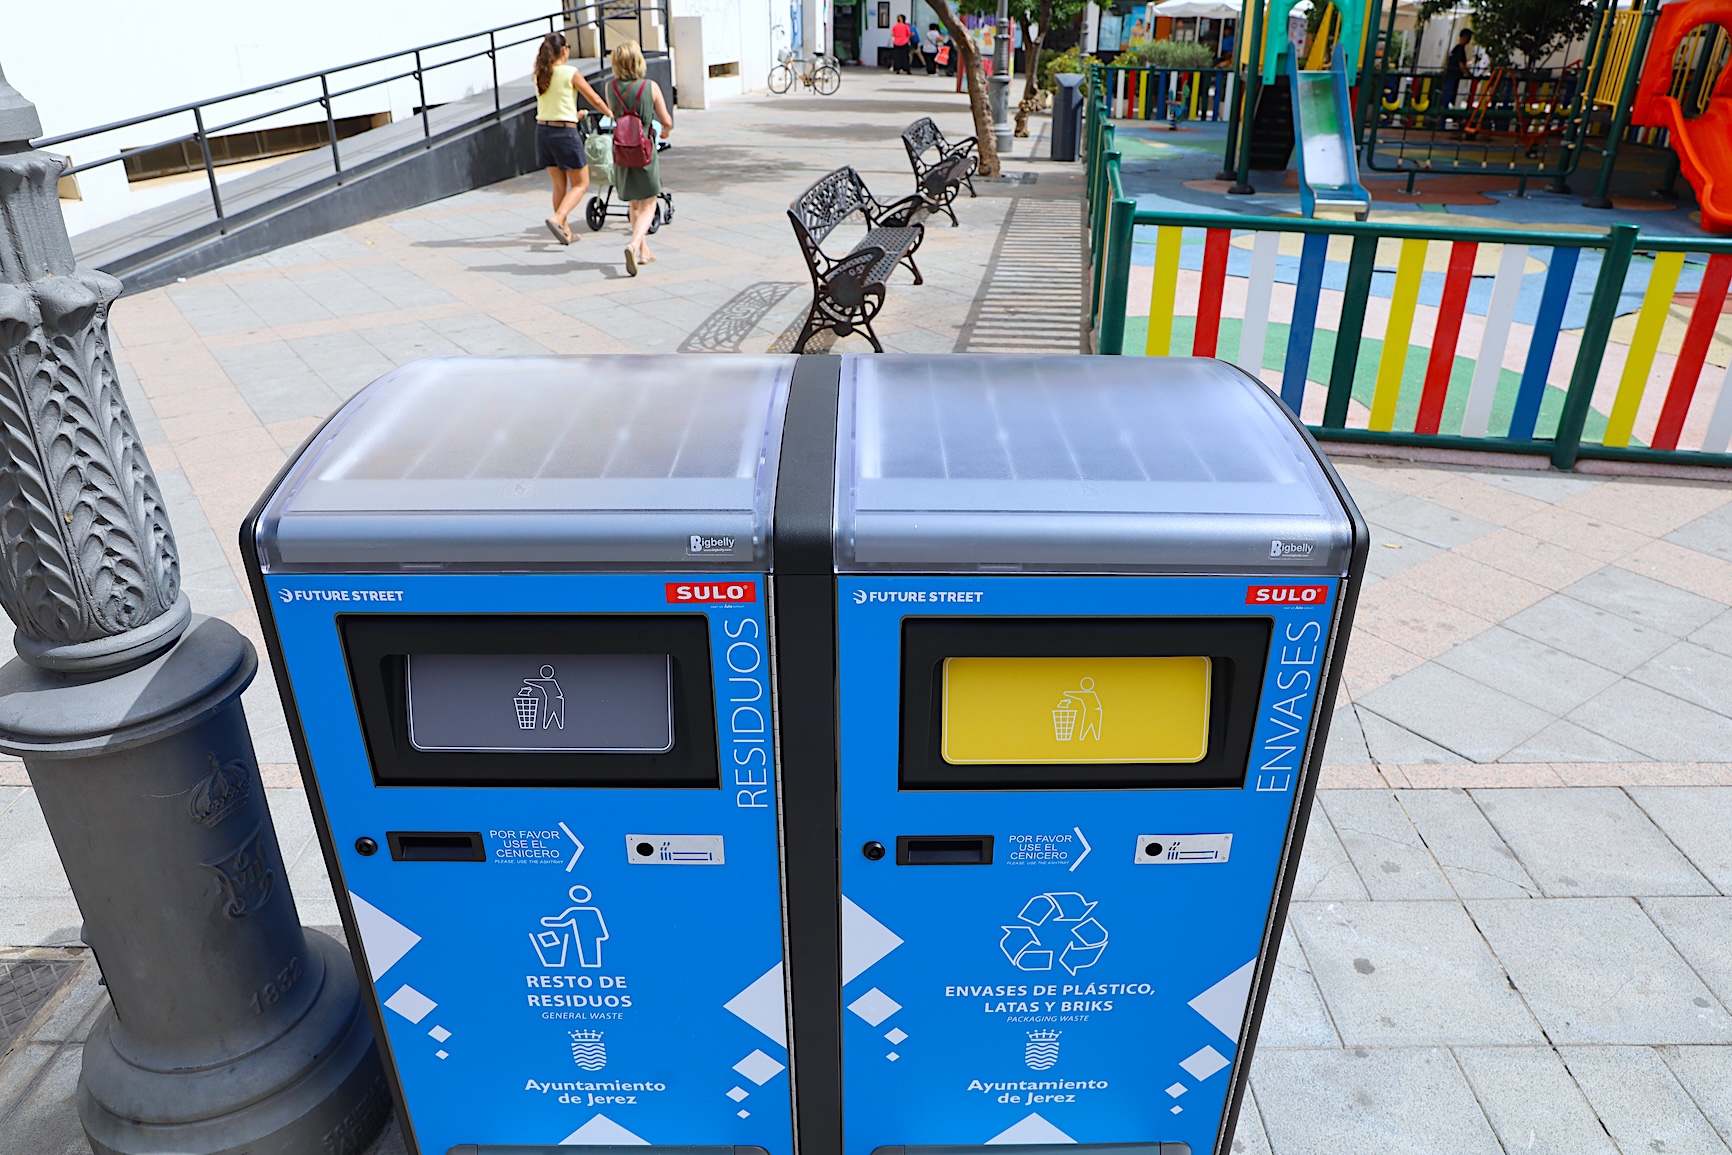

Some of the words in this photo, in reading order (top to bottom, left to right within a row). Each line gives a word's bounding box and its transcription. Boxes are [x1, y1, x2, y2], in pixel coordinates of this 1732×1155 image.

[690, 535, 735, 552] Bigbelly
[1270, 540, 1314, 557] Bigbelly
[294, 590, 350, 601] FUTURE
[352, 591, 403, 601] STREET
[870, 592, 926, 602] FUTURE
[929, 592, 983, 602] STREET
[1256, 621, 1321, 792] ENVASES
[724, 617, 769, 808] RESIDUOS
[489, 830, 516, 839] POR
[519, 830, 560, 839] FAVOR
[1009, 835, 1033, 843] POR
[1035, 834, 1072, 843] FAVOR
[503, 840, 528, 848] USE
[531, 840, 547, 848] EL
[1019, 843, 1041, 851] USE
[1044, 843, 1058, 851] EL
[496, 849, 560, 858] CENICERO
[1010, 851, 1068, 860] CENICERO
[526, 976, 592, 988] RESTO
[599, 976, 626, 988] DE
[946, 986, 1027, 996] ENVASES
[1033, 985, 1056, 996] DE
[1062, 982, 1156, 996] PLÁSTICO,
[528, 995, 632, 1007] RESIDUOS
[985, 1002, 1039, 1012] LATAS
[1045, 1002, 1056, 1012] Y
[1061, 1001, 1112, 1011] BRIKS
[541, 1012, 587, 1020] GENERAL
[589, 1012, 624, 1020] WASTE
[1006, 1015, 1058, 1023] PACKAGING
[525, 1080, 665, 1094] Ayuntamiento
[967, 1079, 1108, 1094] Ayuntamiento
[557, 1093, 582, 1104] de
[588, 1093, 637, 1106] Jerez
[997, 1092, 1021, 1104] de
[1025, 1092, 1075, 1105] Jerez
